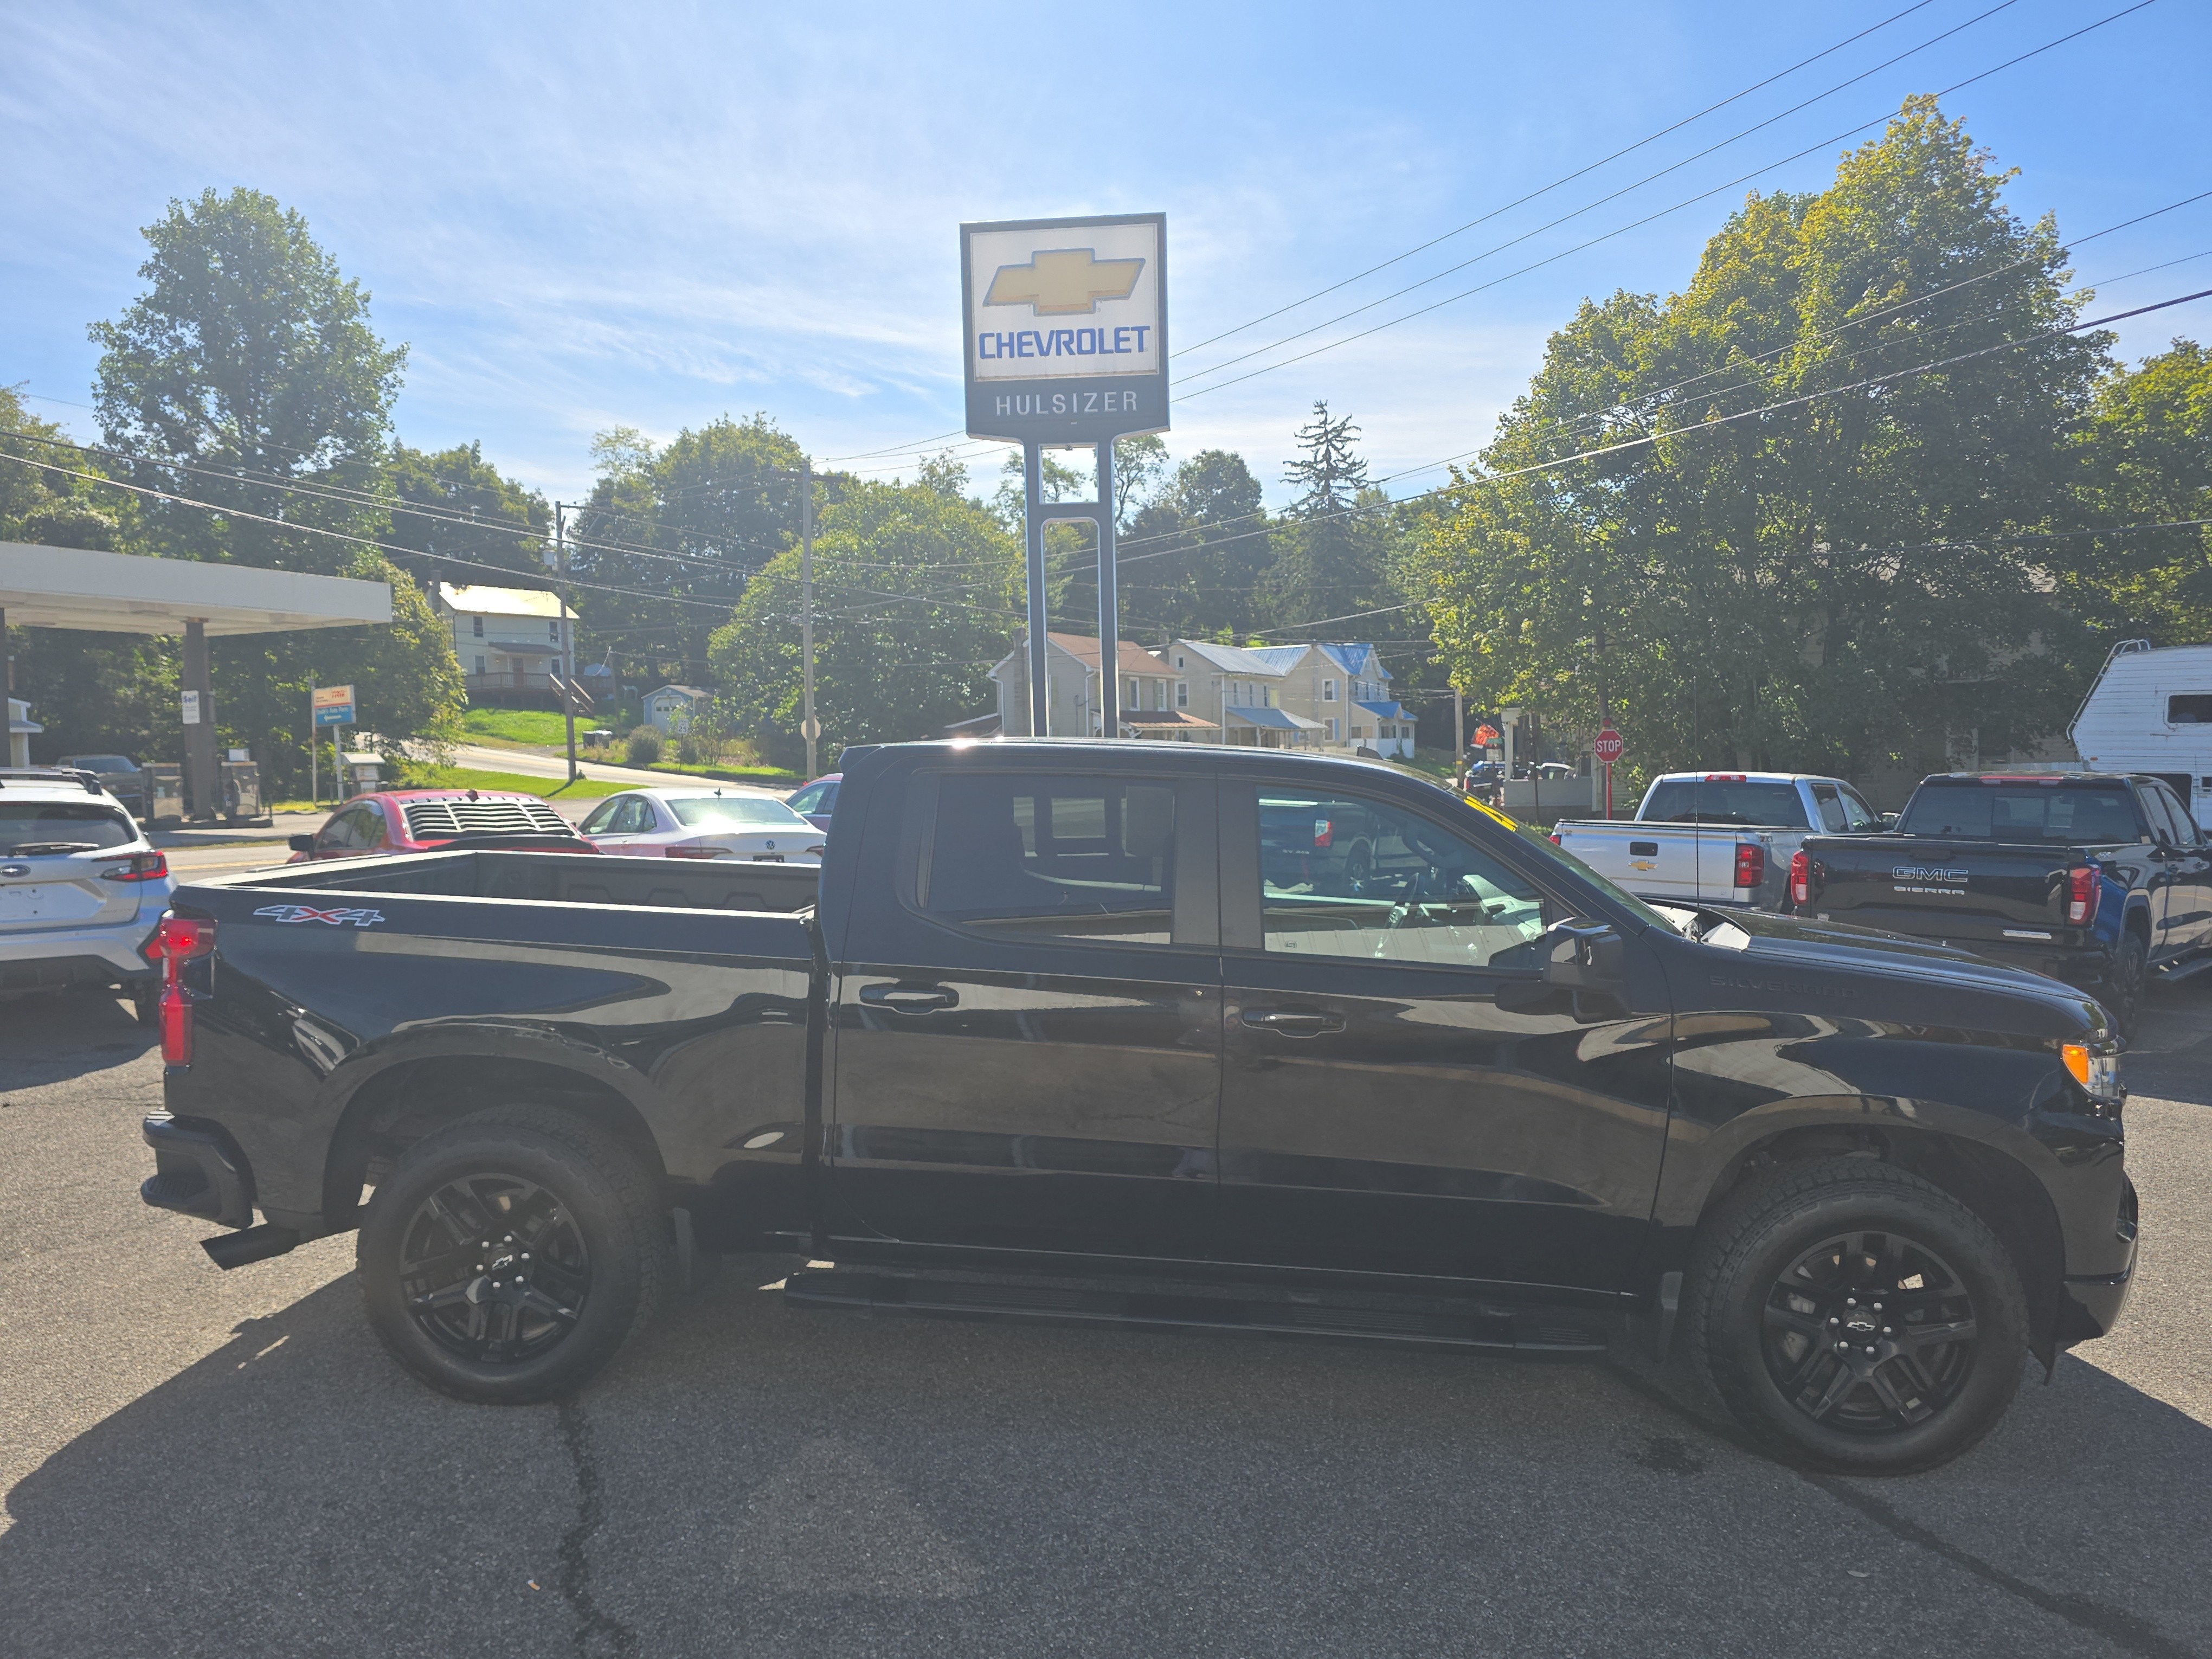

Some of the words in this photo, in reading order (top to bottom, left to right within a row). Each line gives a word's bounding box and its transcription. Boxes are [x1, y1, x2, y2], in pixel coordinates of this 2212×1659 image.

[979, 326, 1150, 359] CHEVROLET
[996, 391, 1137, 416] HULSIZER
[1597, 740, 1621, 753] STOP
[1893, 866, 1969, 883] GMC
